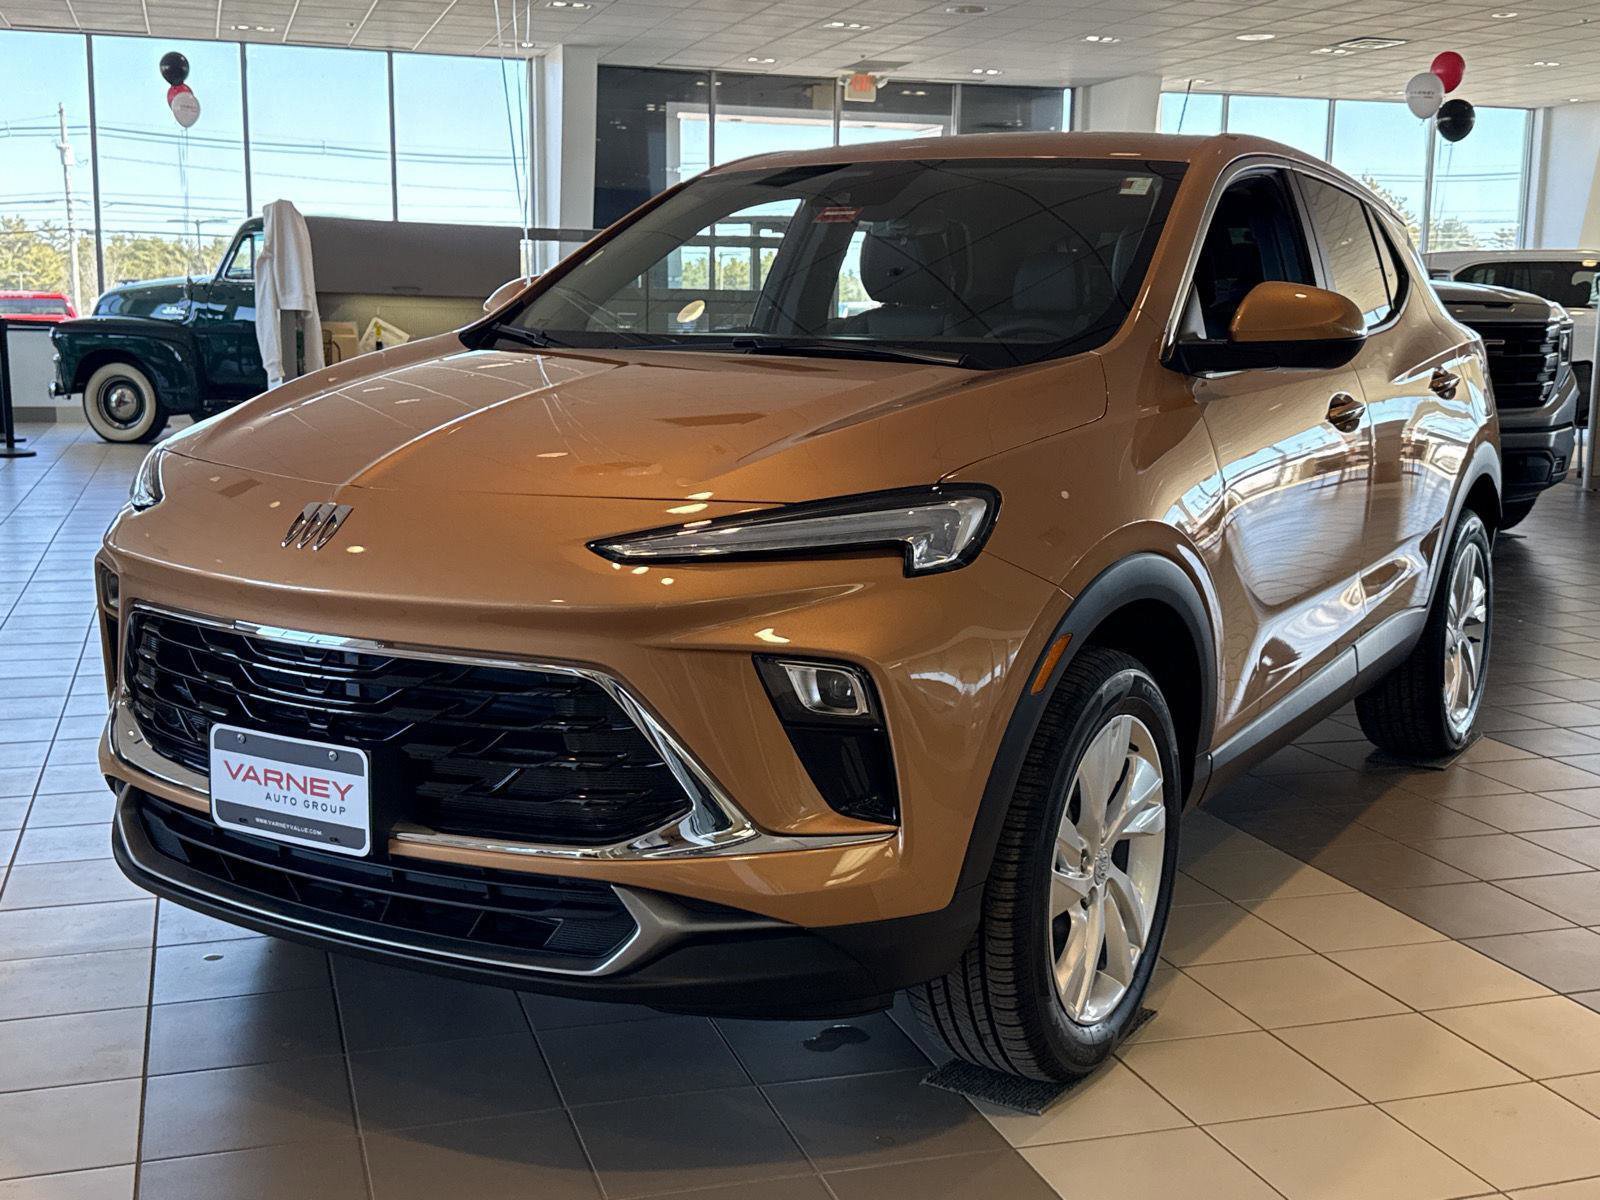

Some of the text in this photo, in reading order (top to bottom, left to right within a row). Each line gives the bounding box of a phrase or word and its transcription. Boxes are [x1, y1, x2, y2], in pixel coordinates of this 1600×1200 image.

[223, 760, 354, 801] VARNEY
[265, 792, 347, 815] AUTO GROUP
[254, 817, 323, 836] WWW.VARNEYVALUE.COM
